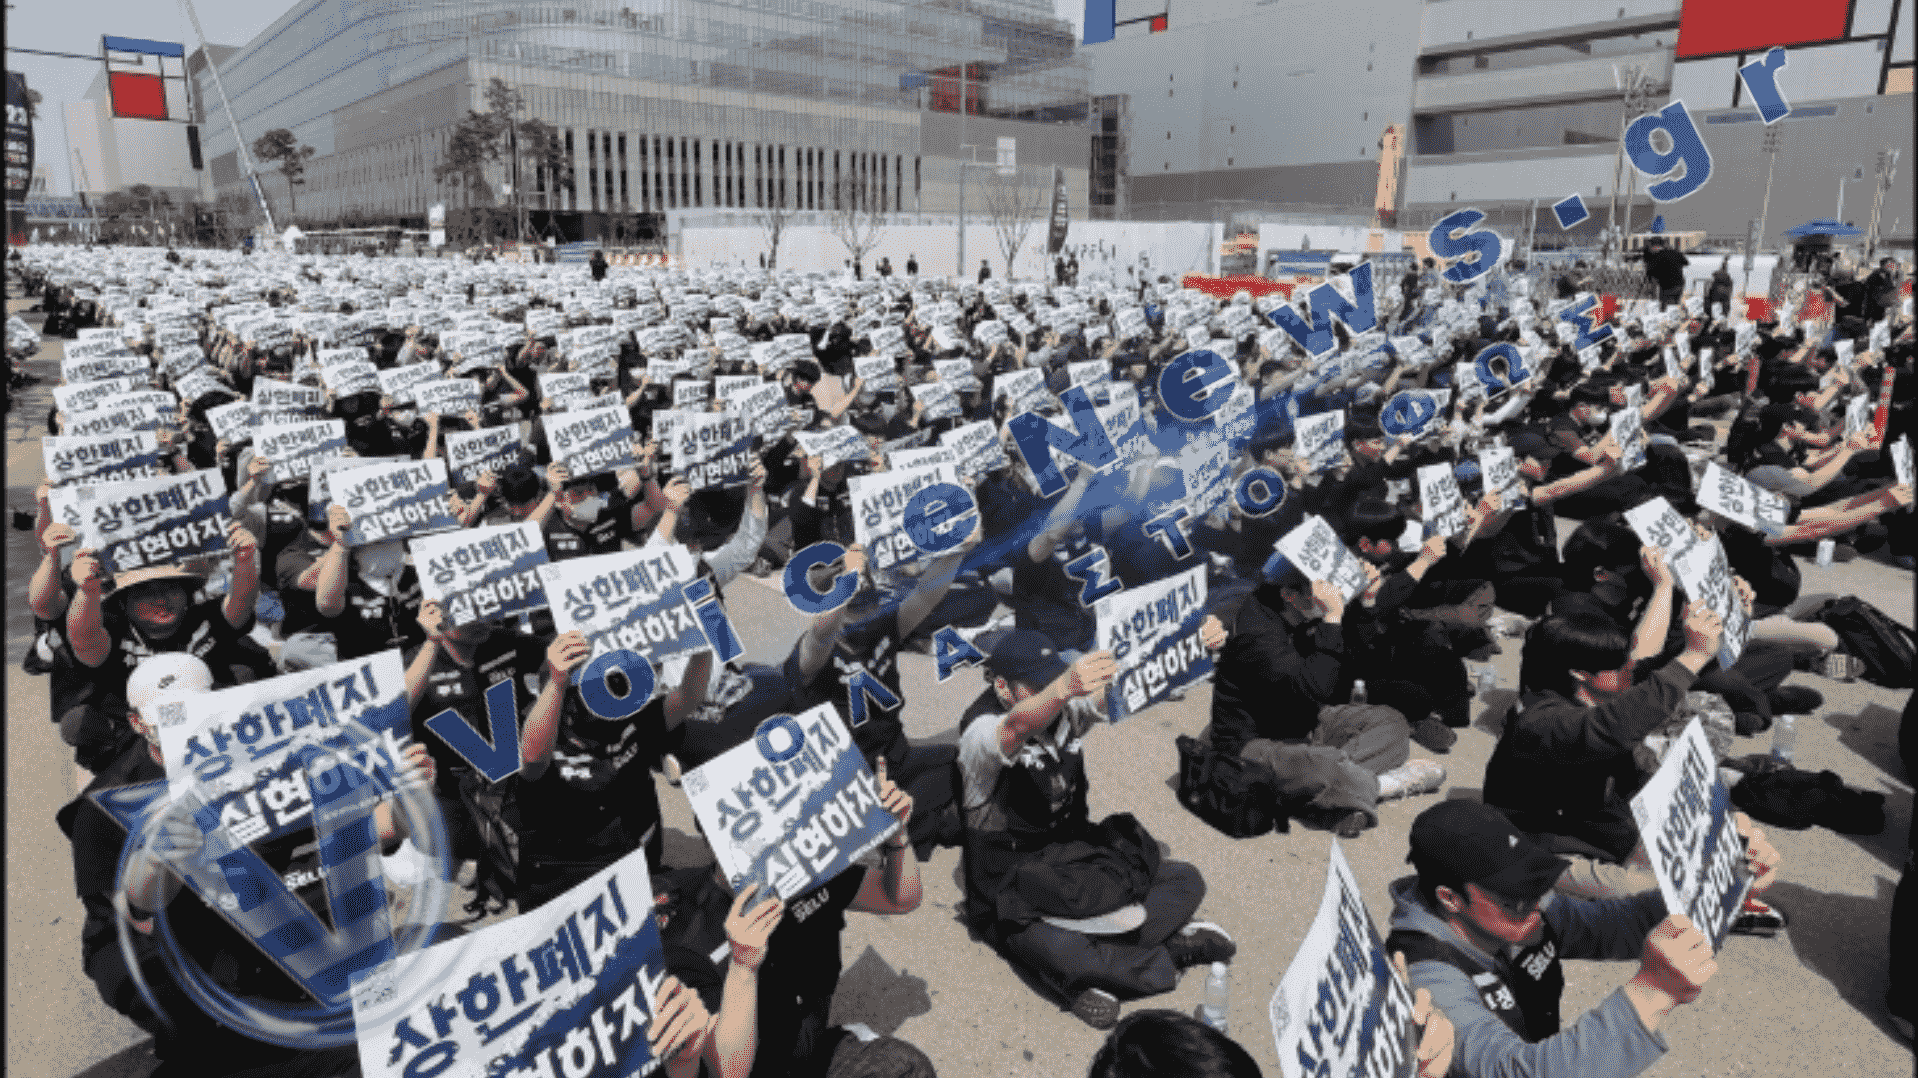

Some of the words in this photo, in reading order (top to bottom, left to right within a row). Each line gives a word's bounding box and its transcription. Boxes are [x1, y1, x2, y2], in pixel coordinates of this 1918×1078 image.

[52, 435, 144, 471] 상한폐지
[553, 410, 622, 449] 상한폐지
[93, 473, 213, 533] 상한폐지
[343, 462, 433, 509] 상한폐지
[113, 512, 234, 572] 실현하자
[360, 495, 452, 541] 실현하자
[427, 527, 530, 586] 상한폐지
[563, 551, 681, 624] 상한폐지
[1110, 574, 1199, 659] 상한폐지
[1122, 631, 1211, 714] 실현하자
[183, 661, 379, 783] 상한폐지
[715, 711, 842, 842] 상한폐지
